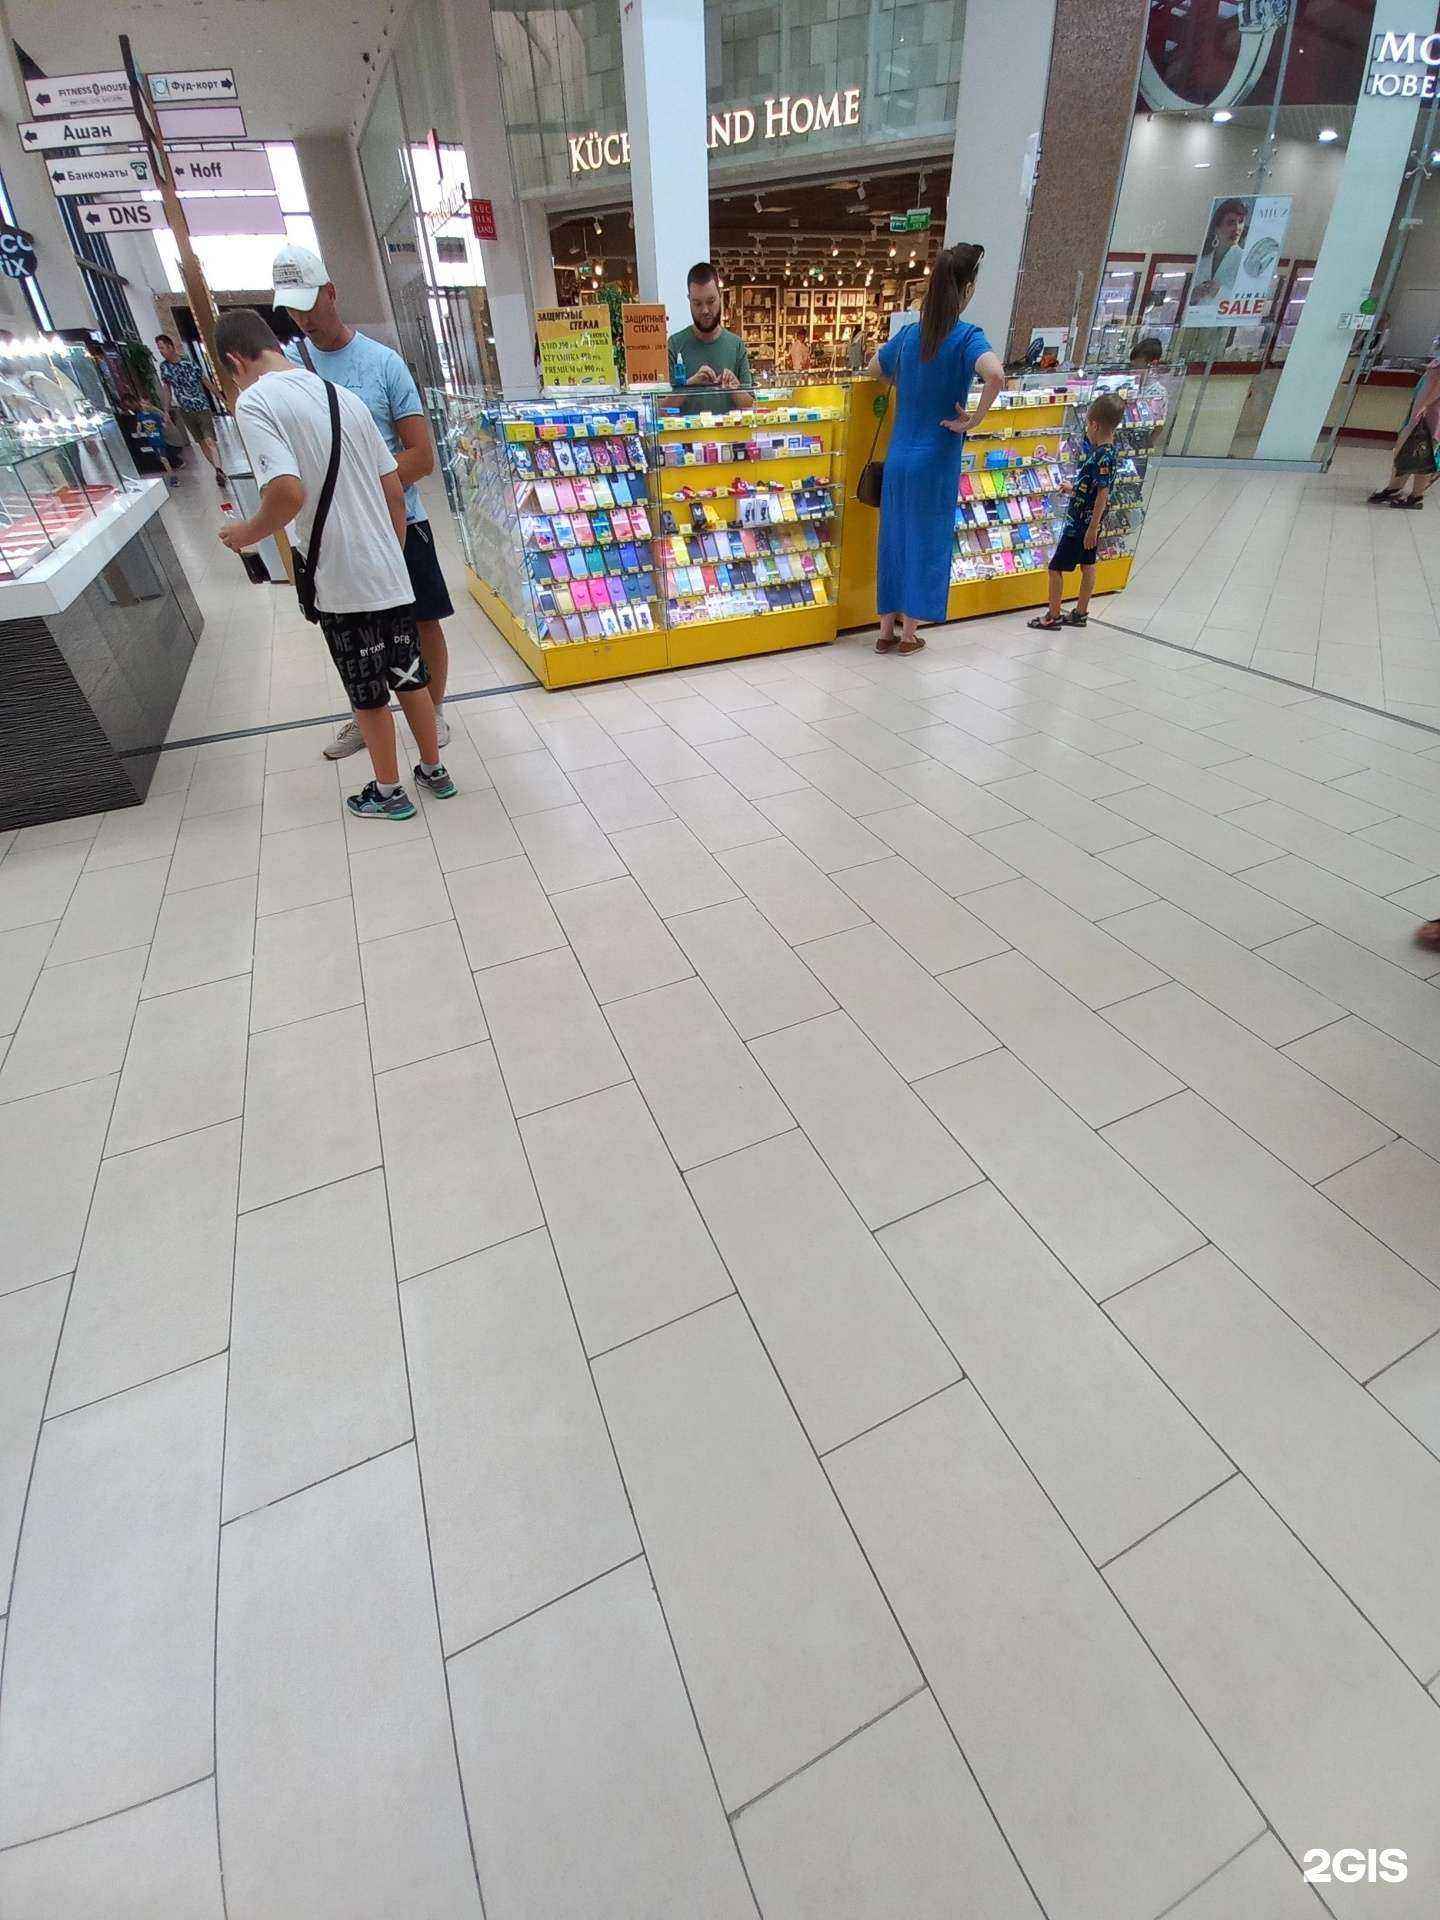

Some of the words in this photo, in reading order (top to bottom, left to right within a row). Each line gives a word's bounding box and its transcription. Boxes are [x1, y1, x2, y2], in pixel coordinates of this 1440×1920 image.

[59, 84, 92, 97] FITNESS
[100, 82, 129, 93] HOUSE
[171, 79, 219, 92] Фуд-корт
[1371, 73, 1440, 99] ЮВЕ
[764, 88, 861, 139] HOME
[63, 124, 112, 141] Ашан
[67, 167, 129, 182] Банкоматы
[190, 161, 223, 179] Hoff
[108, 205, 151, 225] DNS
[1217, 300, 1265, 315] SALE
[537, 310, 584, 322] ЗАЩИТНЫЕ
[624, 314, 666, 324] ЗАЩИТНЫЕ
[569, 319, 600, 331] СТЕКЛА
[633, 324, 660, 334] СТЕКЛА
[632, 369, 659, 383] pixel
